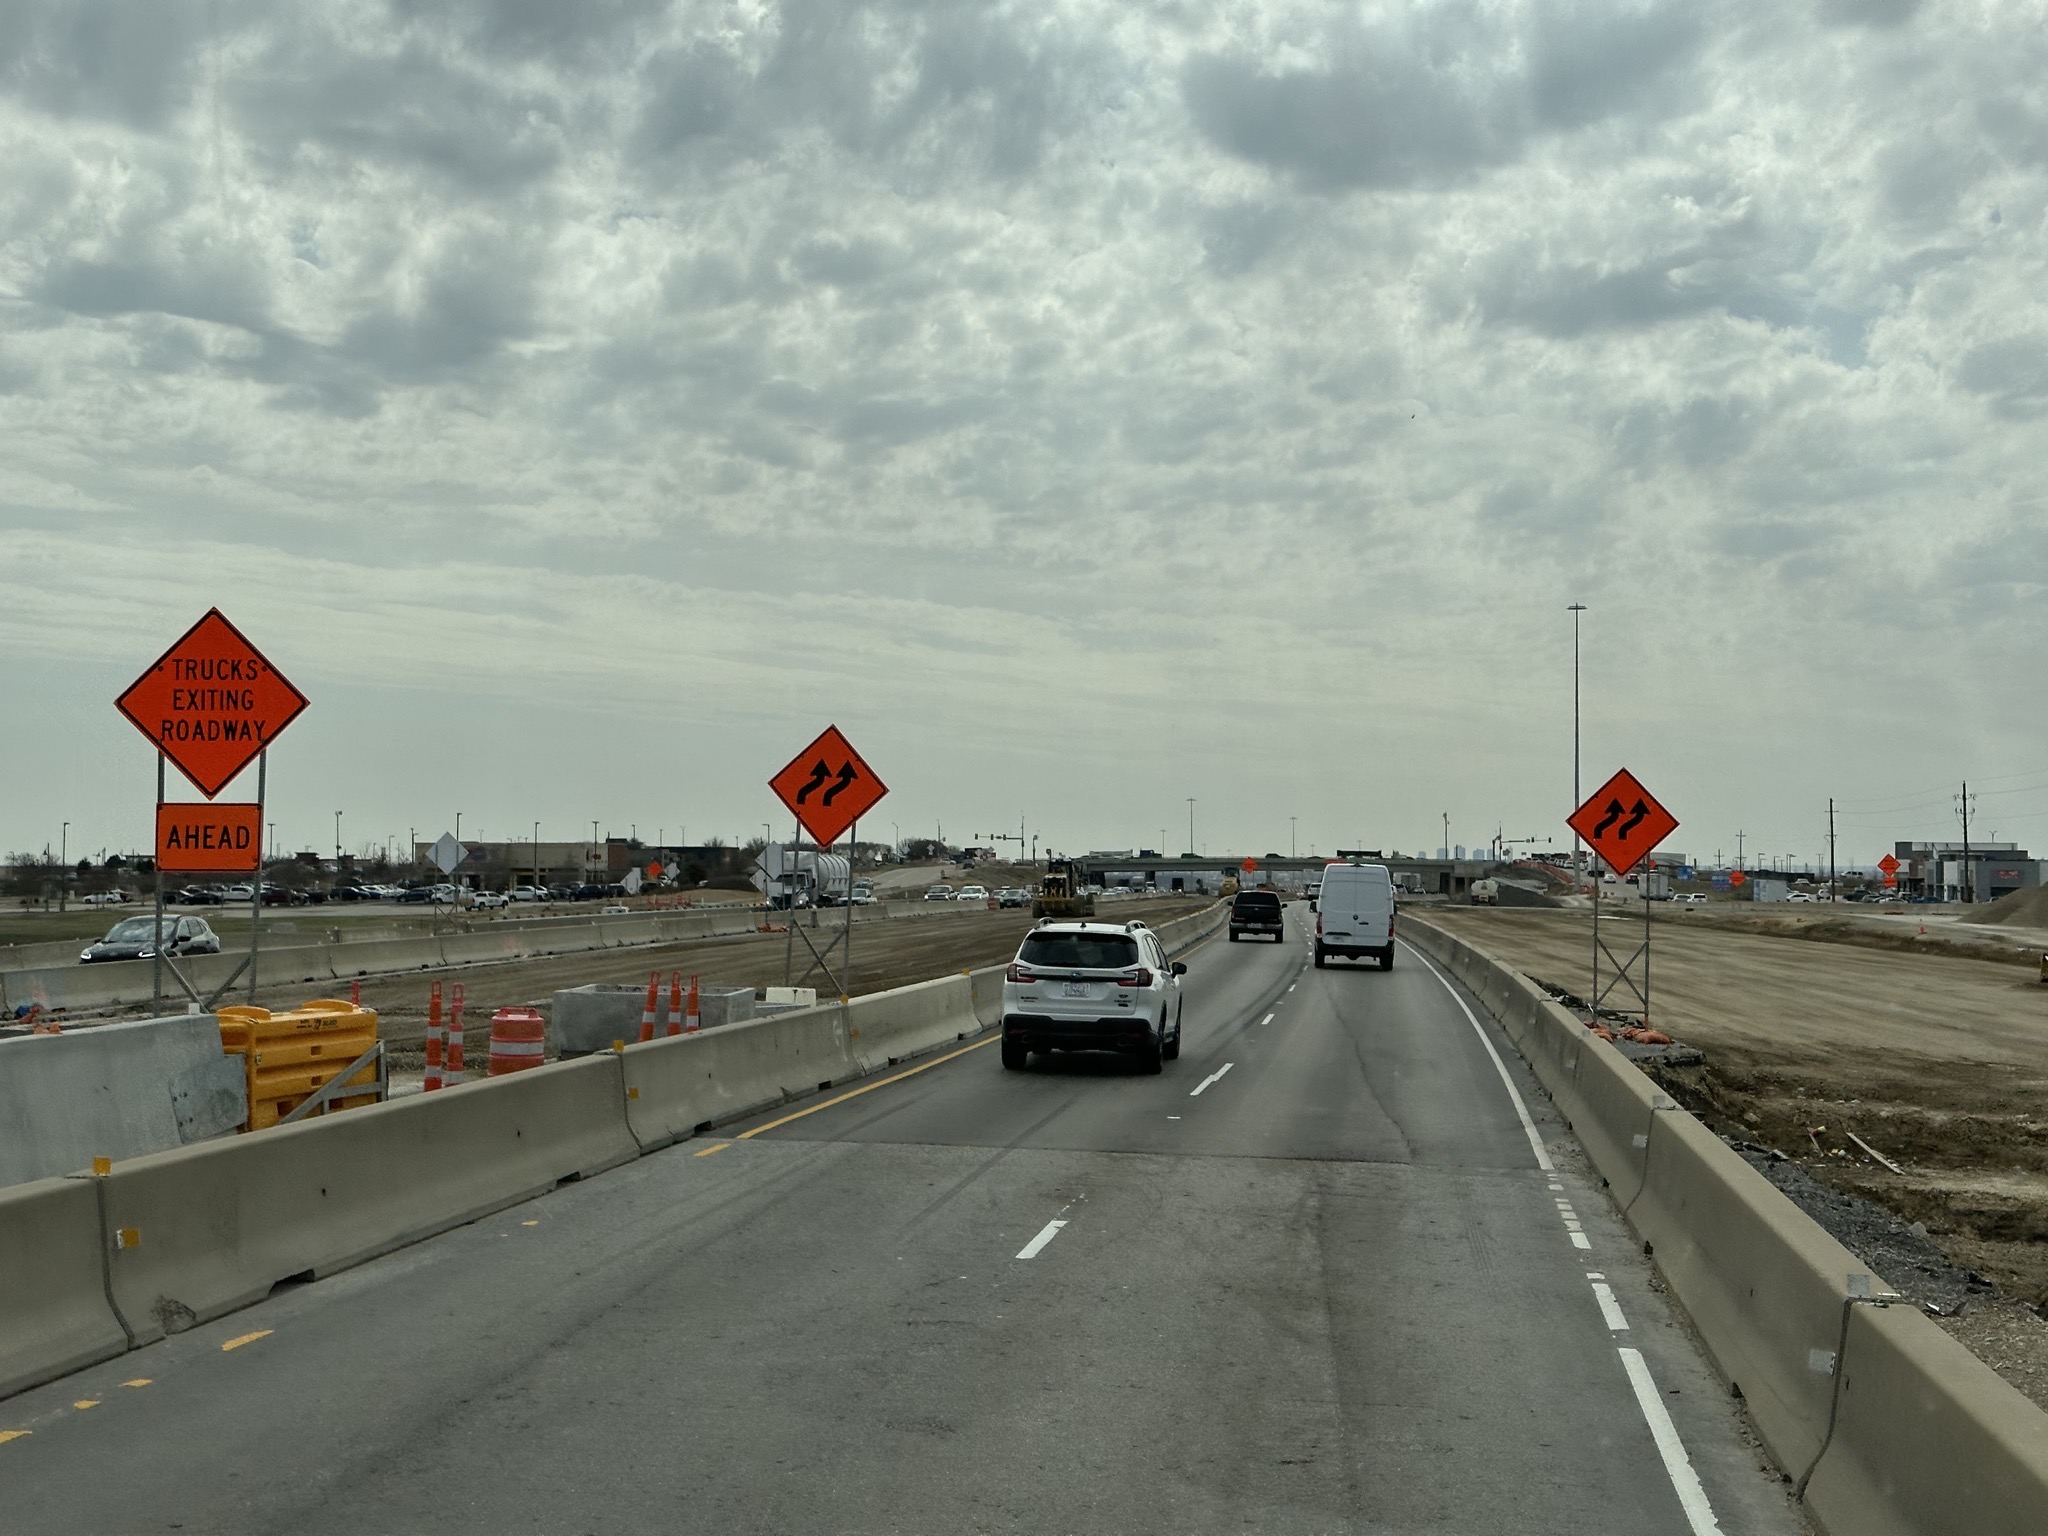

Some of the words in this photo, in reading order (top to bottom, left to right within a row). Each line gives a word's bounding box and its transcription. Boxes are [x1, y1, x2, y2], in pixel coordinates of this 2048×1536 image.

[172, 659, 258, 681] TRUCKS
[173, 689, 254, 711] EXITING
[161, 719, 266, 742] ROADWAY
[166, 824, 250, 850] AHEAD
